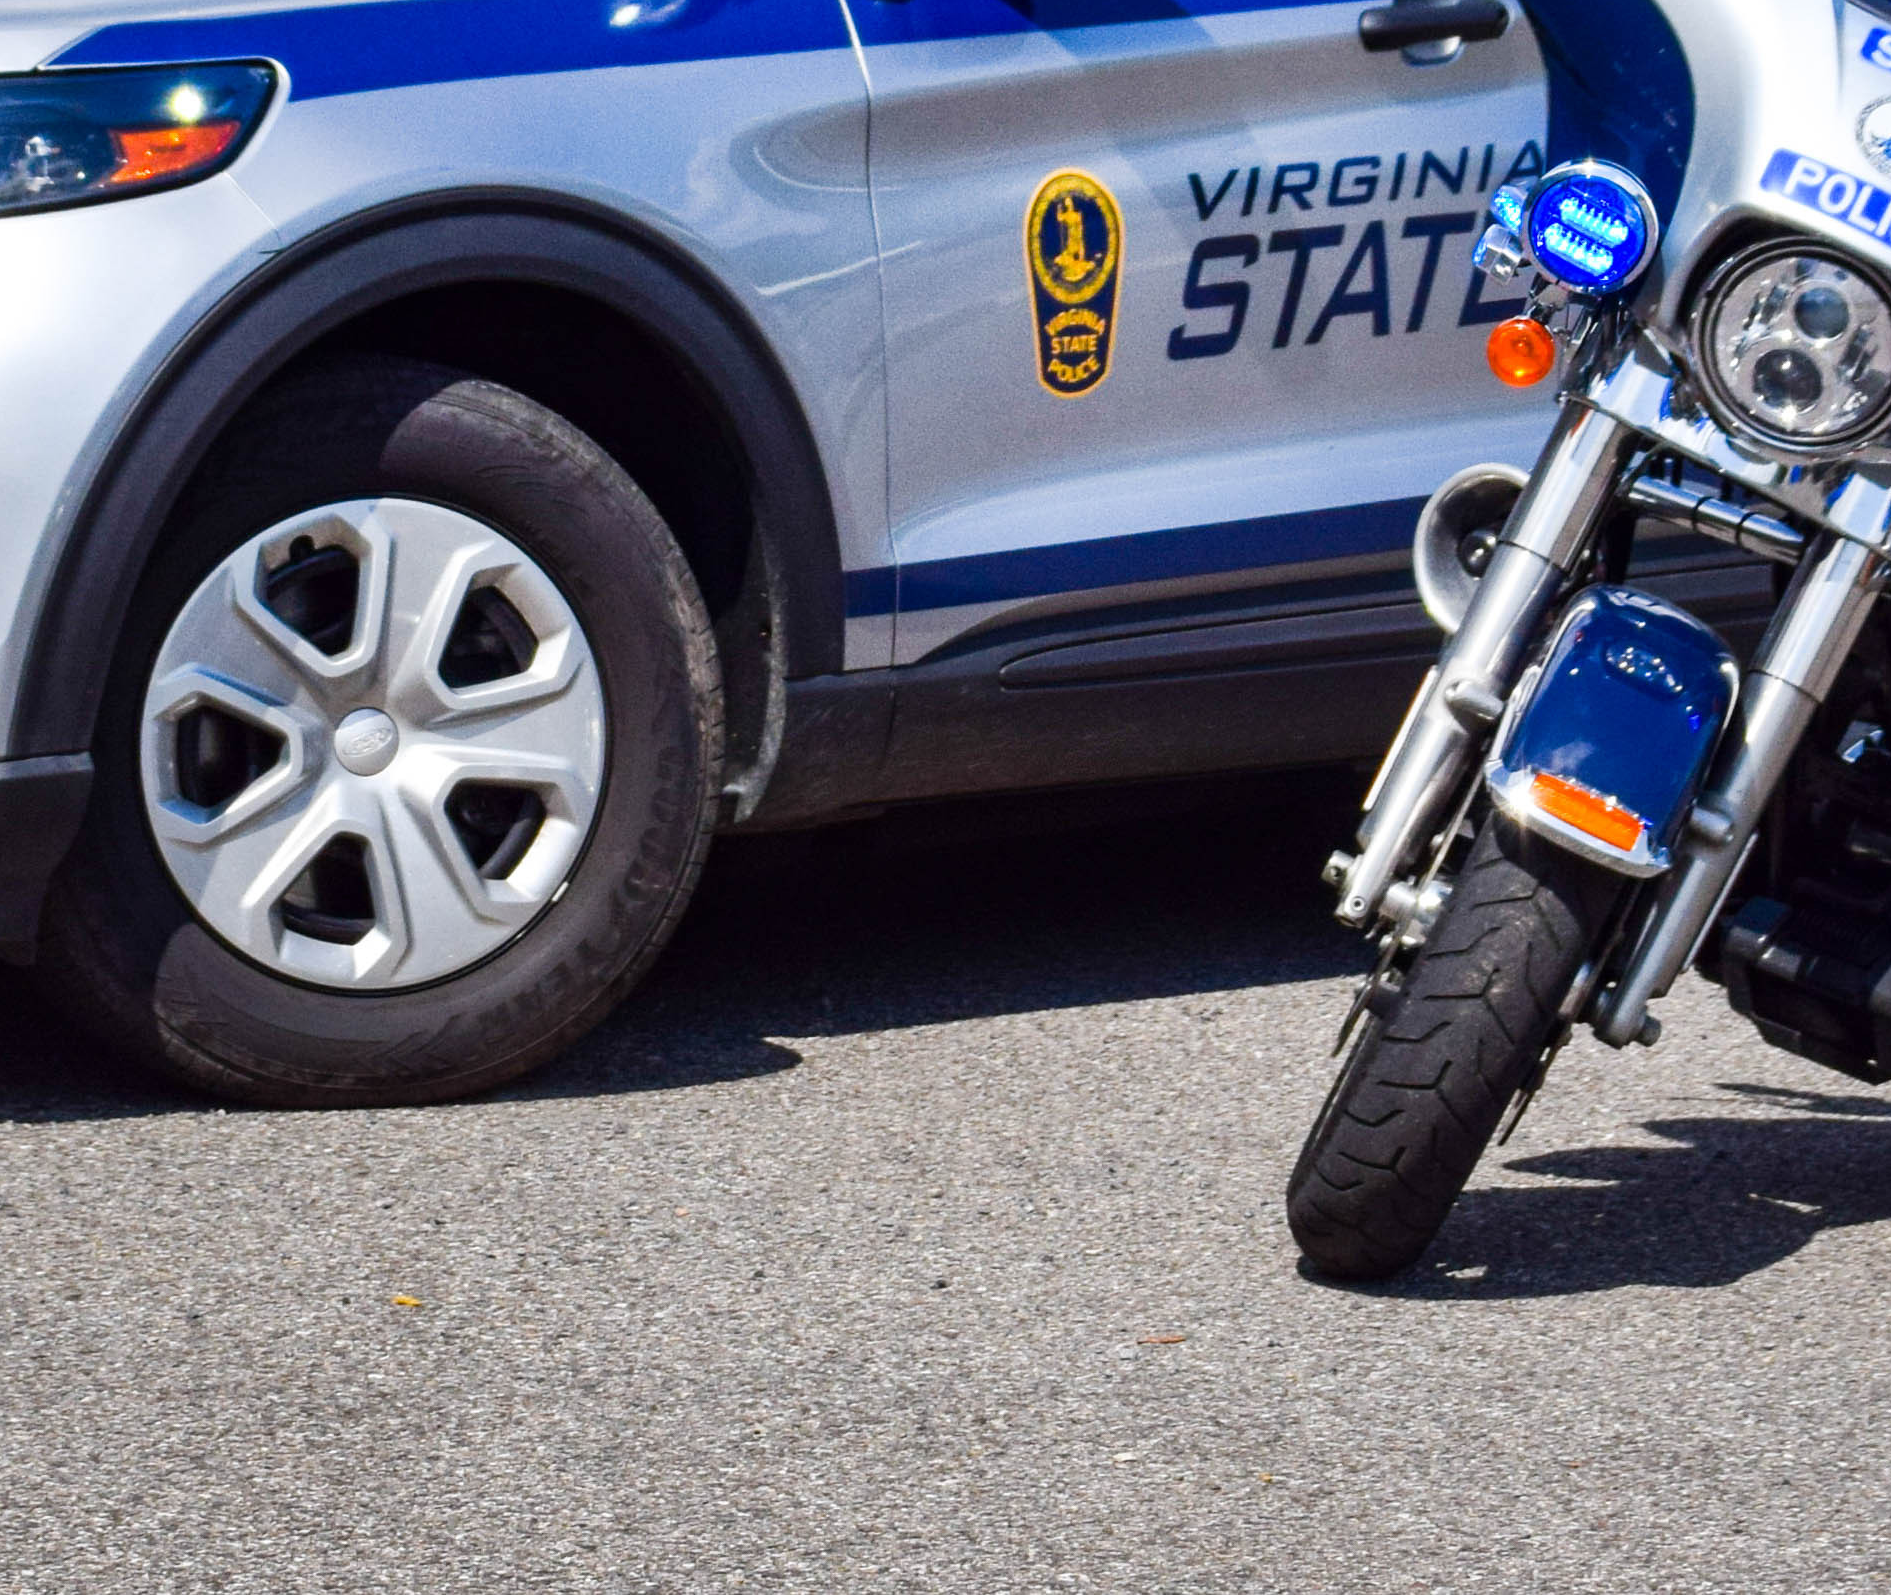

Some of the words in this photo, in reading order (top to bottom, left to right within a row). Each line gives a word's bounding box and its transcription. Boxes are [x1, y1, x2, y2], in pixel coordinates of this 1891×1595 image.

[1187, 139, 1544, 222] VIRGINIA
[1044, 307, 1107, 337] VIRGINIA
[1050, 335, 1098, 354] STATE
[1047, 354, 1102, 384] POLICE
